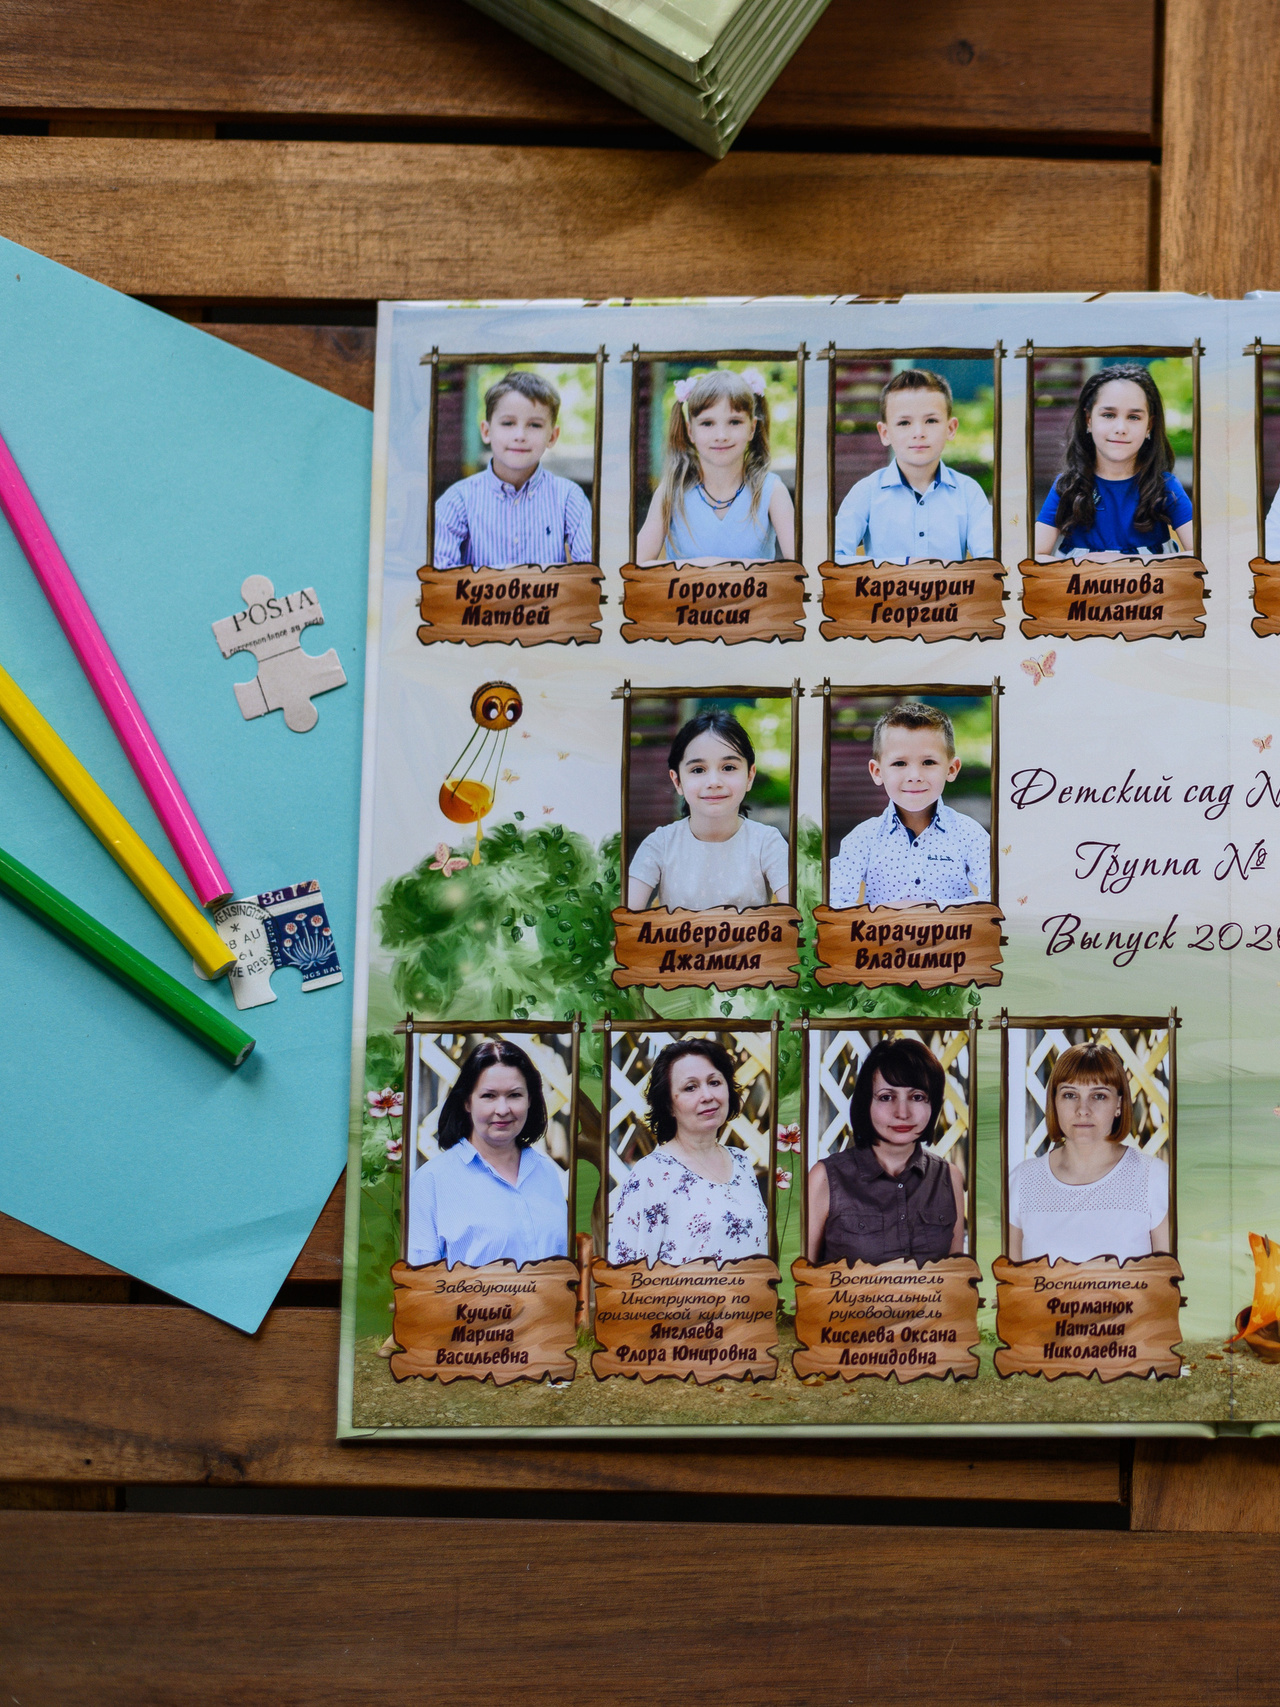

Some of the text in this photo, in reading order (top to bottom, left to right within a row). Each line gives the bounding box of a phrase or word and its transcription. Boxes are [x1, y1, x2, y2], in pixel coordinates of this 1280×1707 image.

[455, 578, 560, 605] Кузовкин
[668, 576, 768, 605] Горохова
[855, 575, 975, 602] Карачурин
[1066, 572, 1164, 595] Аминова
[461, 604, 550, 627] Матвей
[676, 604, 750, 627] Таисия
[871, 602, 959, 628] Георгий
[1067, 599, 1163, 622] Милания
[1010, 767, 1173, 810] Детский
[1183, 783, 1234, 821] сад
[1075, 841, 1201, 894] Группа
[1214, 839, 1267, 881] №
[261, 891, 286, 905] 3d
[244, 928, 261, 944] AU
[637, 920, 783, 946] Аливердиева
[850, 919, 973, 947] Карачурин
[1041, 913, 1179, 968] Выпуск
[659, 950, 762, 974] Джамиля
[855, 948, 966, 973] Владимир
[434, 1279, 537, 1297] Заведующий
[631, 1272, 745, 1288] Воспитатель
[830, 1271, 944, 1287] Воспитатель
[1034, 1276, 1148, 1292] Воспитатель
[621, 1291, 750, 1307] Инструктор по
[827, 1290, 942, 1307] Музыкальный
[1047, 1297, 1134, 1318] Фирманюк
[456, 1303, 512, 1324] Куцый
[597, 1308, 773, 1323] физической культуре
[829, 1305, 943, 1322] руководитель
[451, 1326, 514, 1345] Марина
[650, 1323, 724, 1340] Янгляева
[820, 1326, 957, 1343] Киселева Оксана
[1055, 1319, 1125, 1337] Наталия
[436, 1347, 529, 1365] Васильевна
[616, 1344, 757, 1365] Флора Юнировна
[838, 1347, 937, 1366] Леонидовна
[1043, 1341, 1137, 1360] Николаевна
